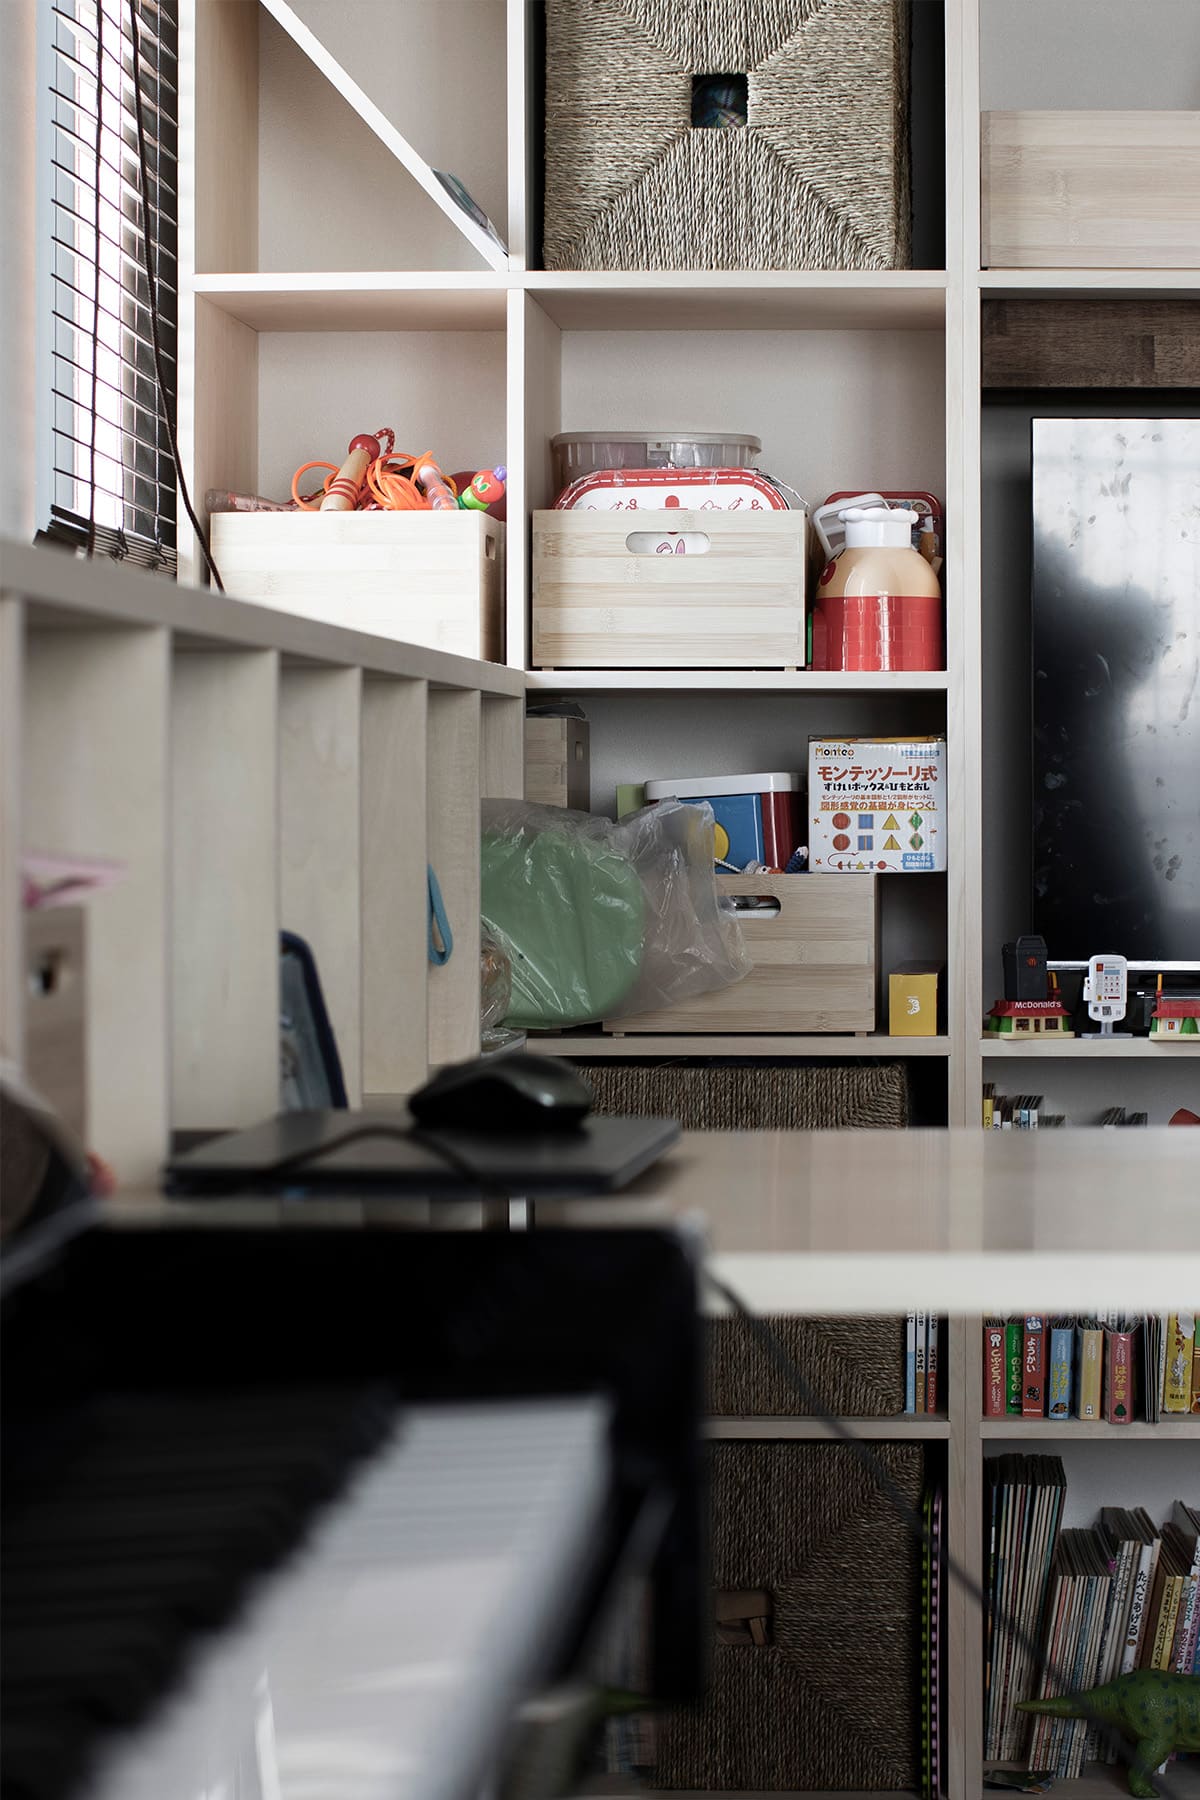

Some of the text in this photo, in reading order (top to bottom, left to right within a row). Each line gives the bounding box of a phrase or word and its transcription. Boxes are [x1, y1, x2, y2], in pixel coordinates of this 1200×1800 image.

[817, 765, 938, 782] モンテッソーリ式
[1026, 1337, 1036, 1373] ようかい
[1128, 1570, 1147, 1636] たべてあげる
[1184, 1586, 1195, 1622] クリスマス
[1154, 1583, 1172, 1669] だるまちゃんとてんぐち
